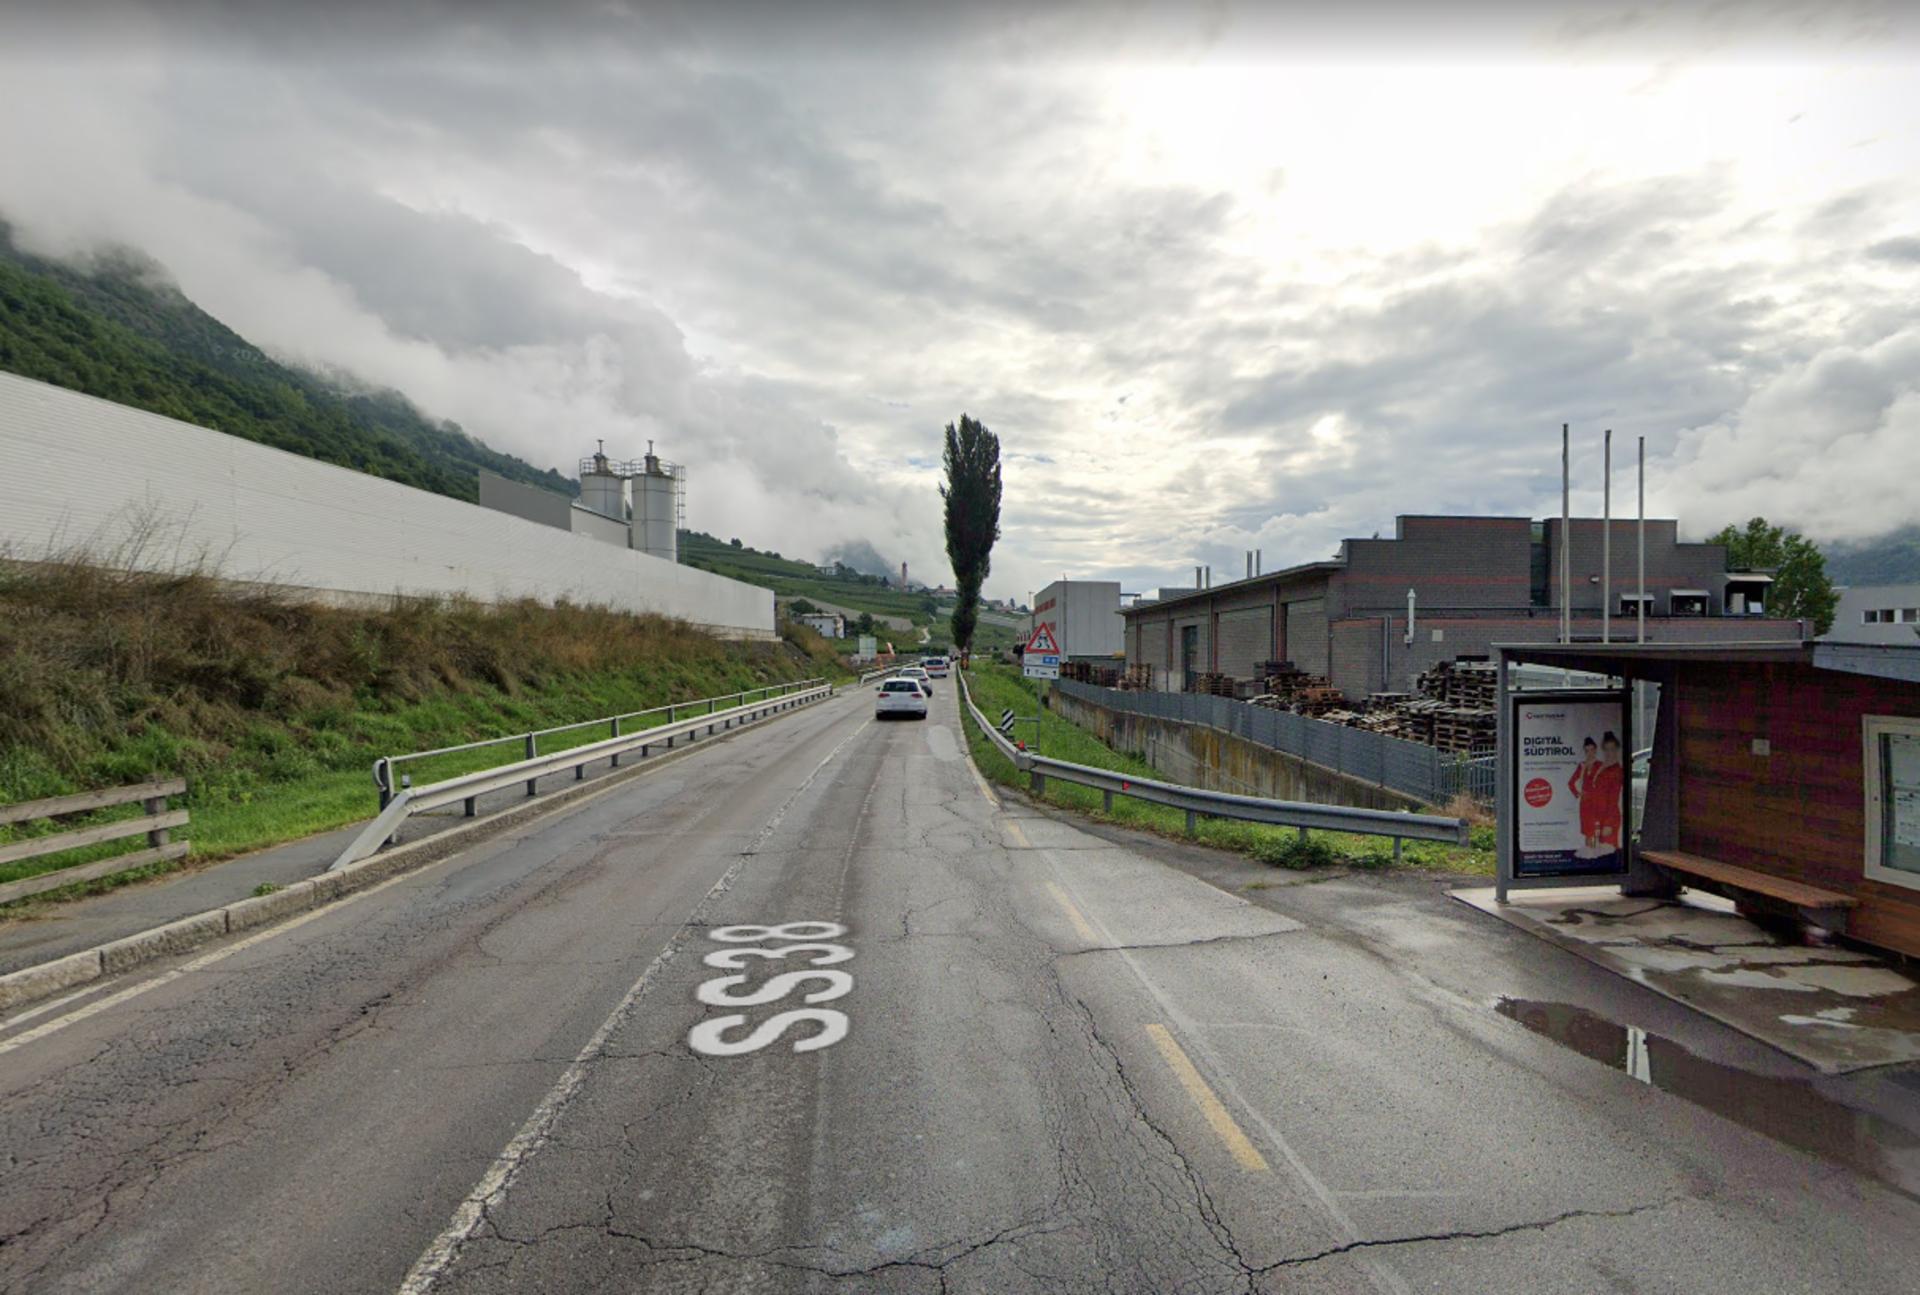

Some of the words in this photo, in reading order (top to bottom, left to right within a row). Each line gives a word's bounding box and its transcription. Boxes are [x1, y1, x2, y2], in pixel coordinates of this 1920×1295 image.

[1524, 736, 1564, 745] DIGITAL
[1524, 746, 1575, 756] SÜDTIROL
[688, 920, 855, 1056] SS38
